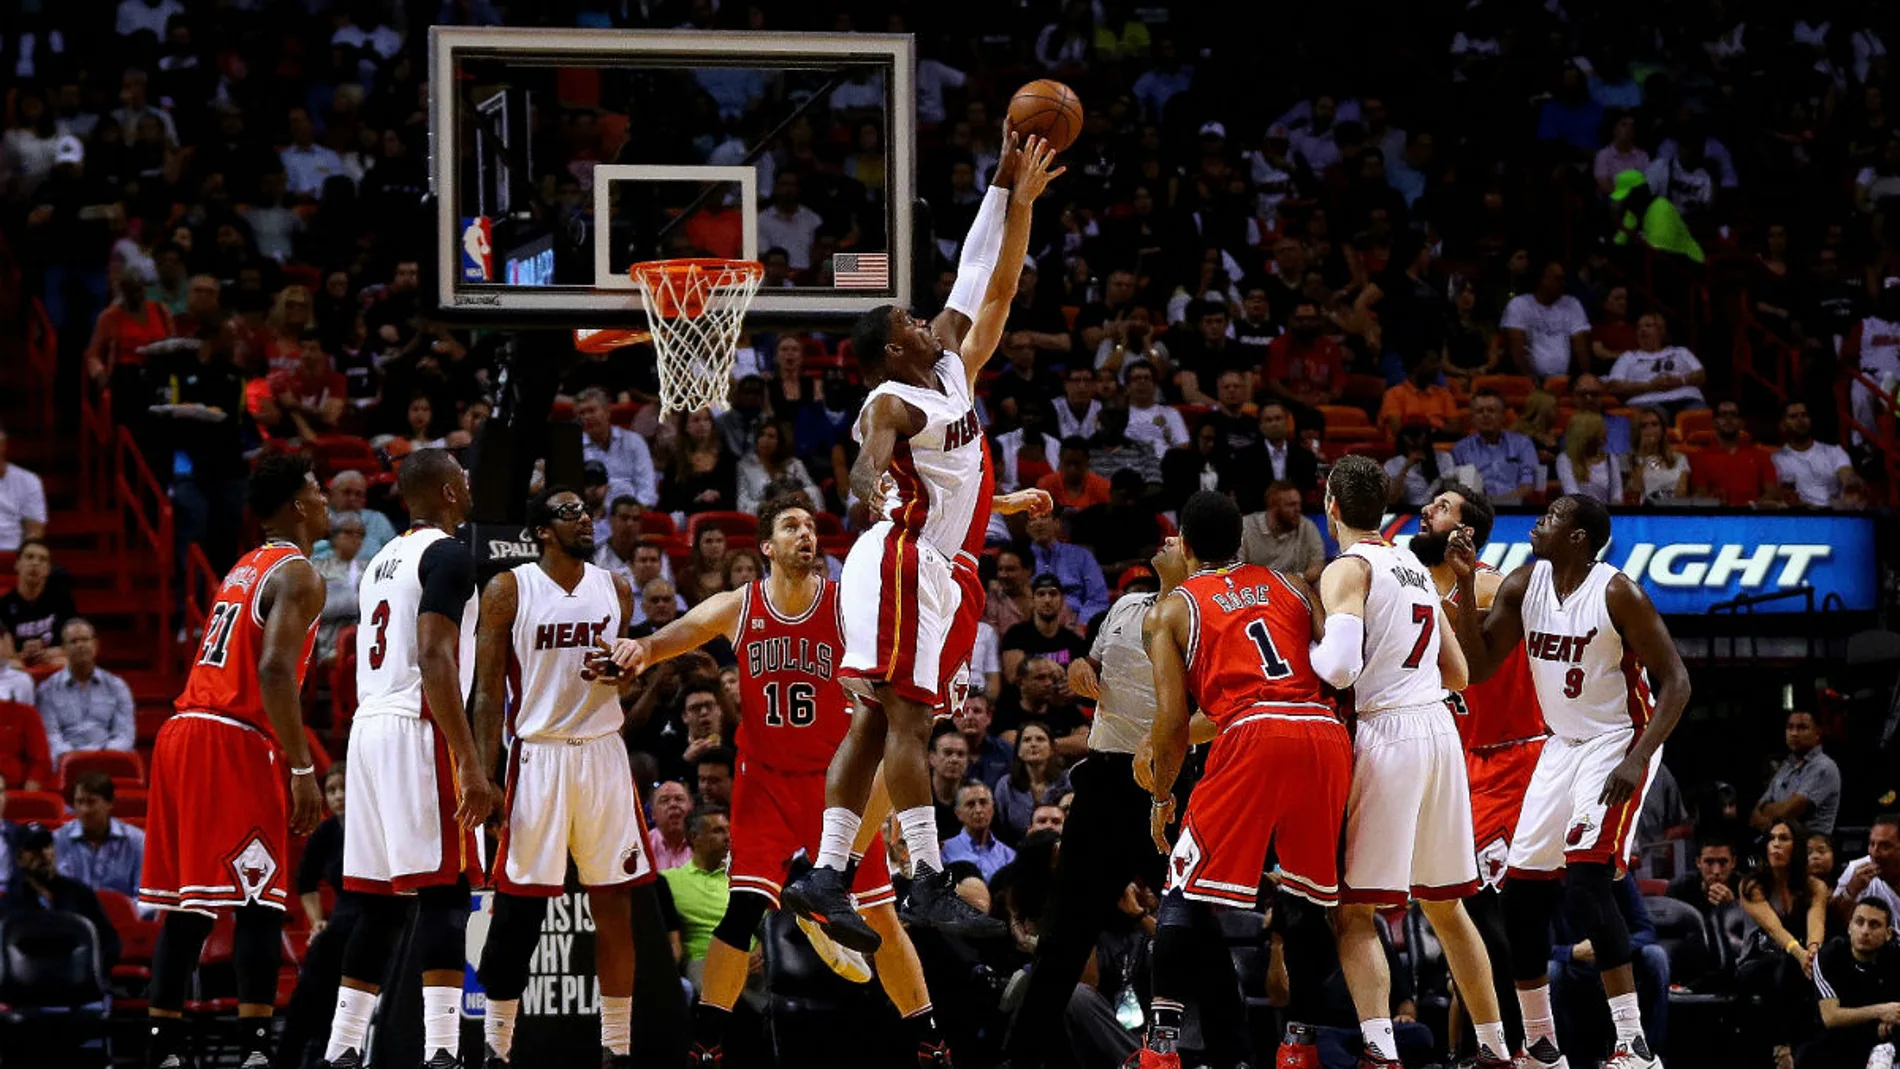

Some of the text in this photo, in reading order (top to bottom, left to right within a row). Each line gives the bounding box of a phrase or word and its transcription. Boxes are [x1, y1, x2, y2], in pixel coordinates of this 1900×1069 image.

[943, 409, 979, 453] HEA
[488, 539, 540, 559] SPALL
[1594, 536, 1832, 587] IGHT
[1212, 585, 1269, 613] ROSE
[198, 601, 242, 668] 21
[369, 599, 390, 671] 3
[535, 614, 611, 650] HEAT
[1244, 618, 1294, 680] 1
[1401, 602, 1434, 669] 7
[1528, 626, 1598, 663] HEAT
[747, 636, 832, 681] BULLS
[1563, 667, 1585, 699] 9
[763, 681, 817, 728] 16
[541, 892, 571, 932] IS
[465, 992, 486, 1010] NB
[561, 975, 601, 1015] PLA
